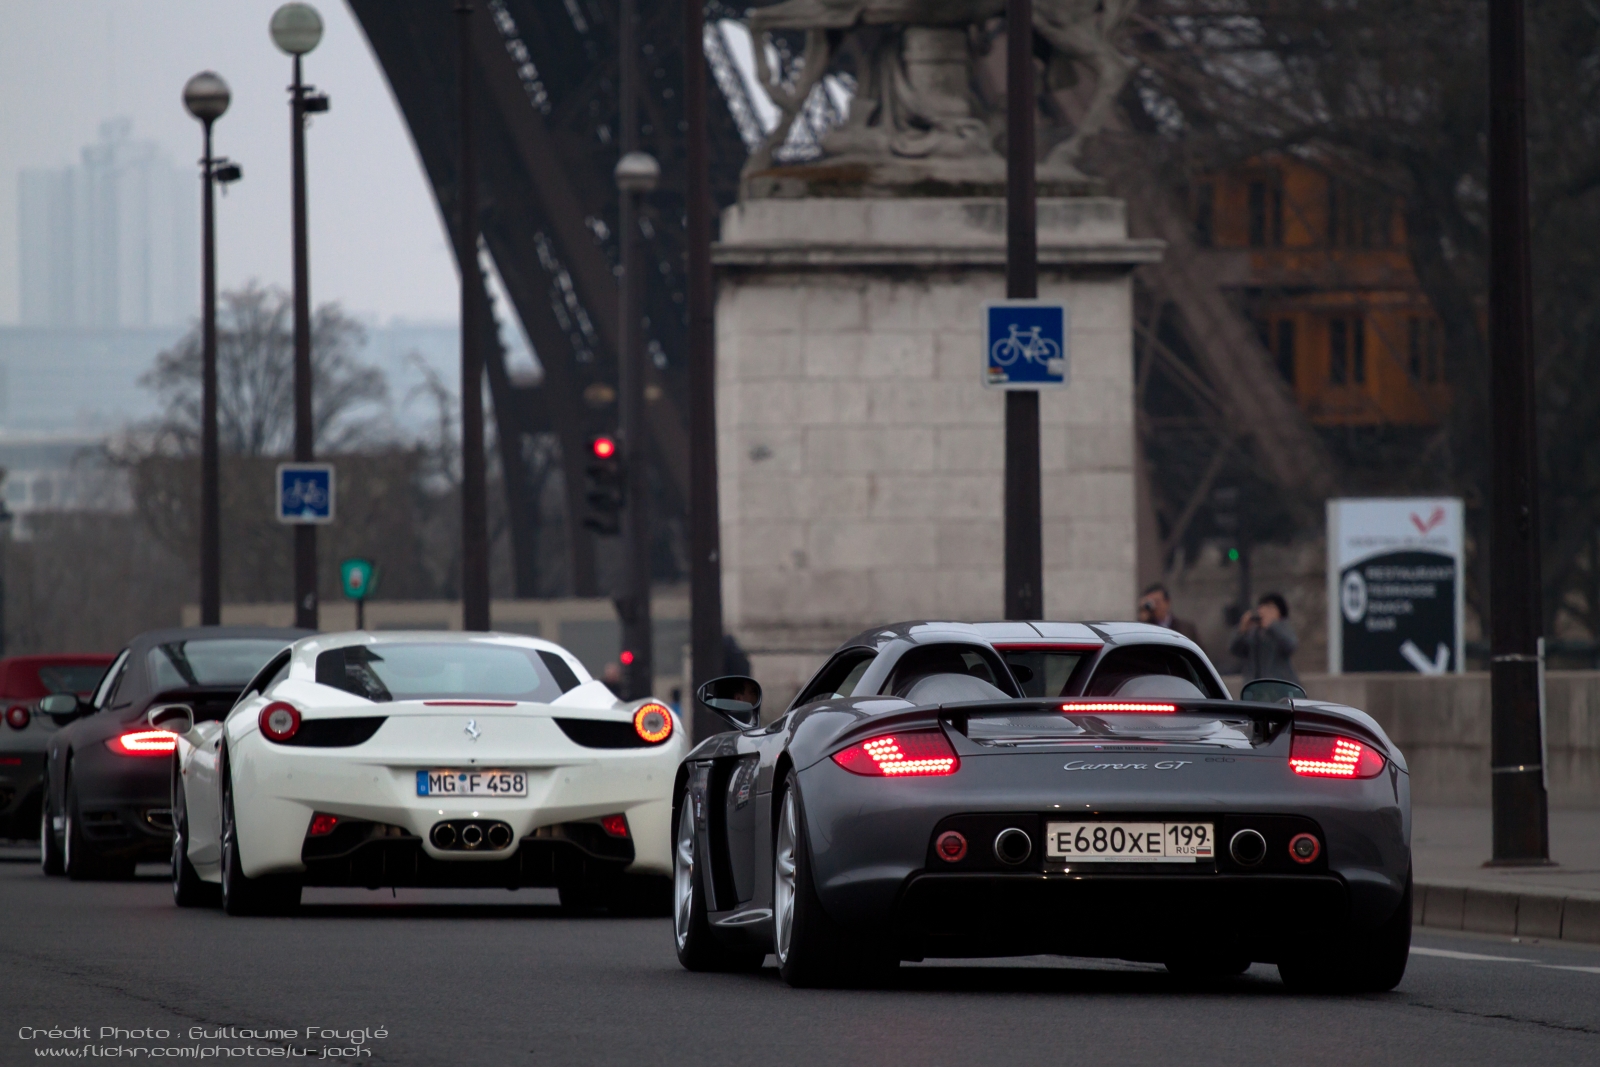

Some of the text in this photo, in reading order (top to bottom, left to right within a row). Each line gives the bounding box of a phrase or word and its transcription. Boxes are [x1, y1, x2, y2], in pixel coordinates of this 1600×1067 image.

[1063, 760, 1193, 771] Carrera GT
[429, 774, 524, 792] MG F 458
[1176, 846, 1196, 854] RUS
